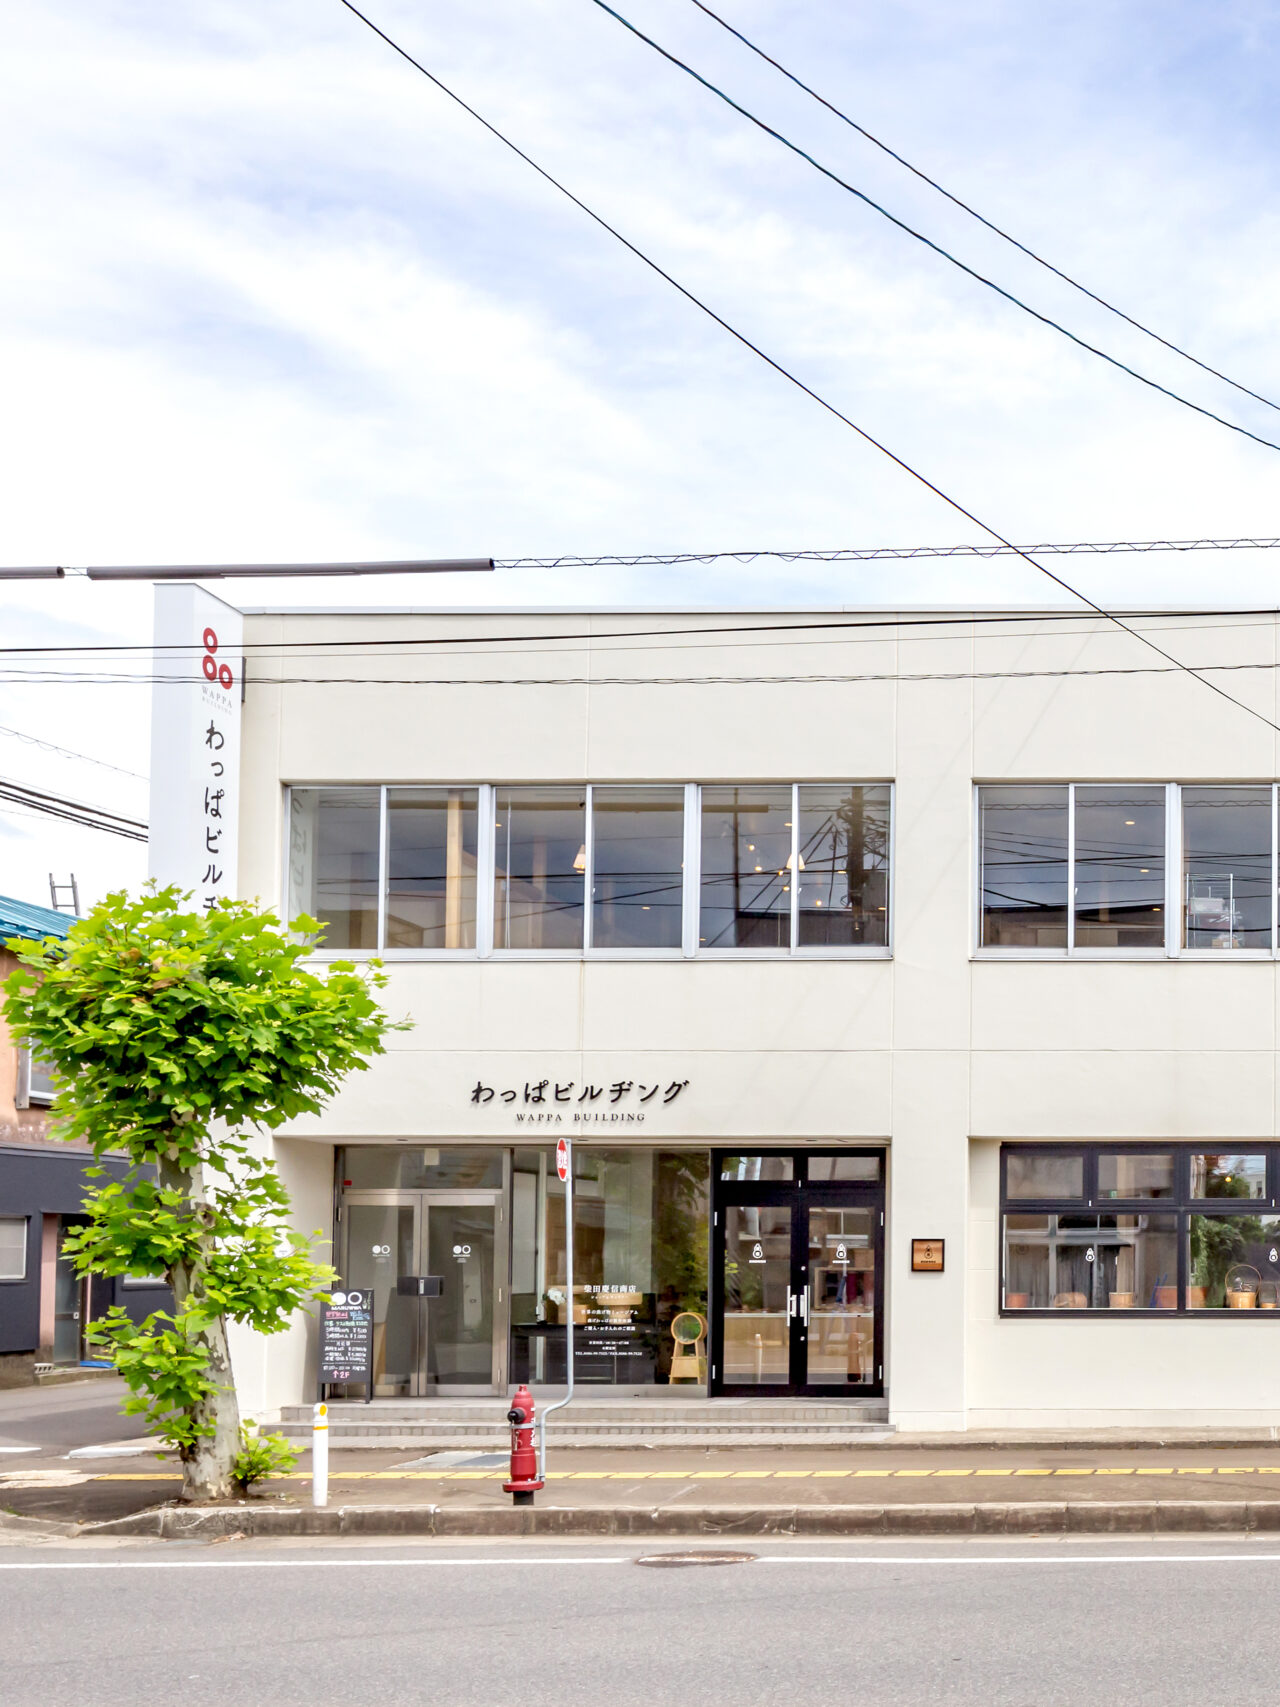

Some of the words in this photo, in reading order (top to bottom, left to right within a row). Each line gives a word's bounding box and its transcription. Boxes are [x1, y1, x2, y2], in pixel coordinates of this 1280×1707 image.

[201, 685, 233, 709] WAPPA
[471, 1079, 690, 1104] わっぱビルヂング
[516, 1113, 563, 1122] WAPPA
[574, 1113, 646, 1122] BUILDING
